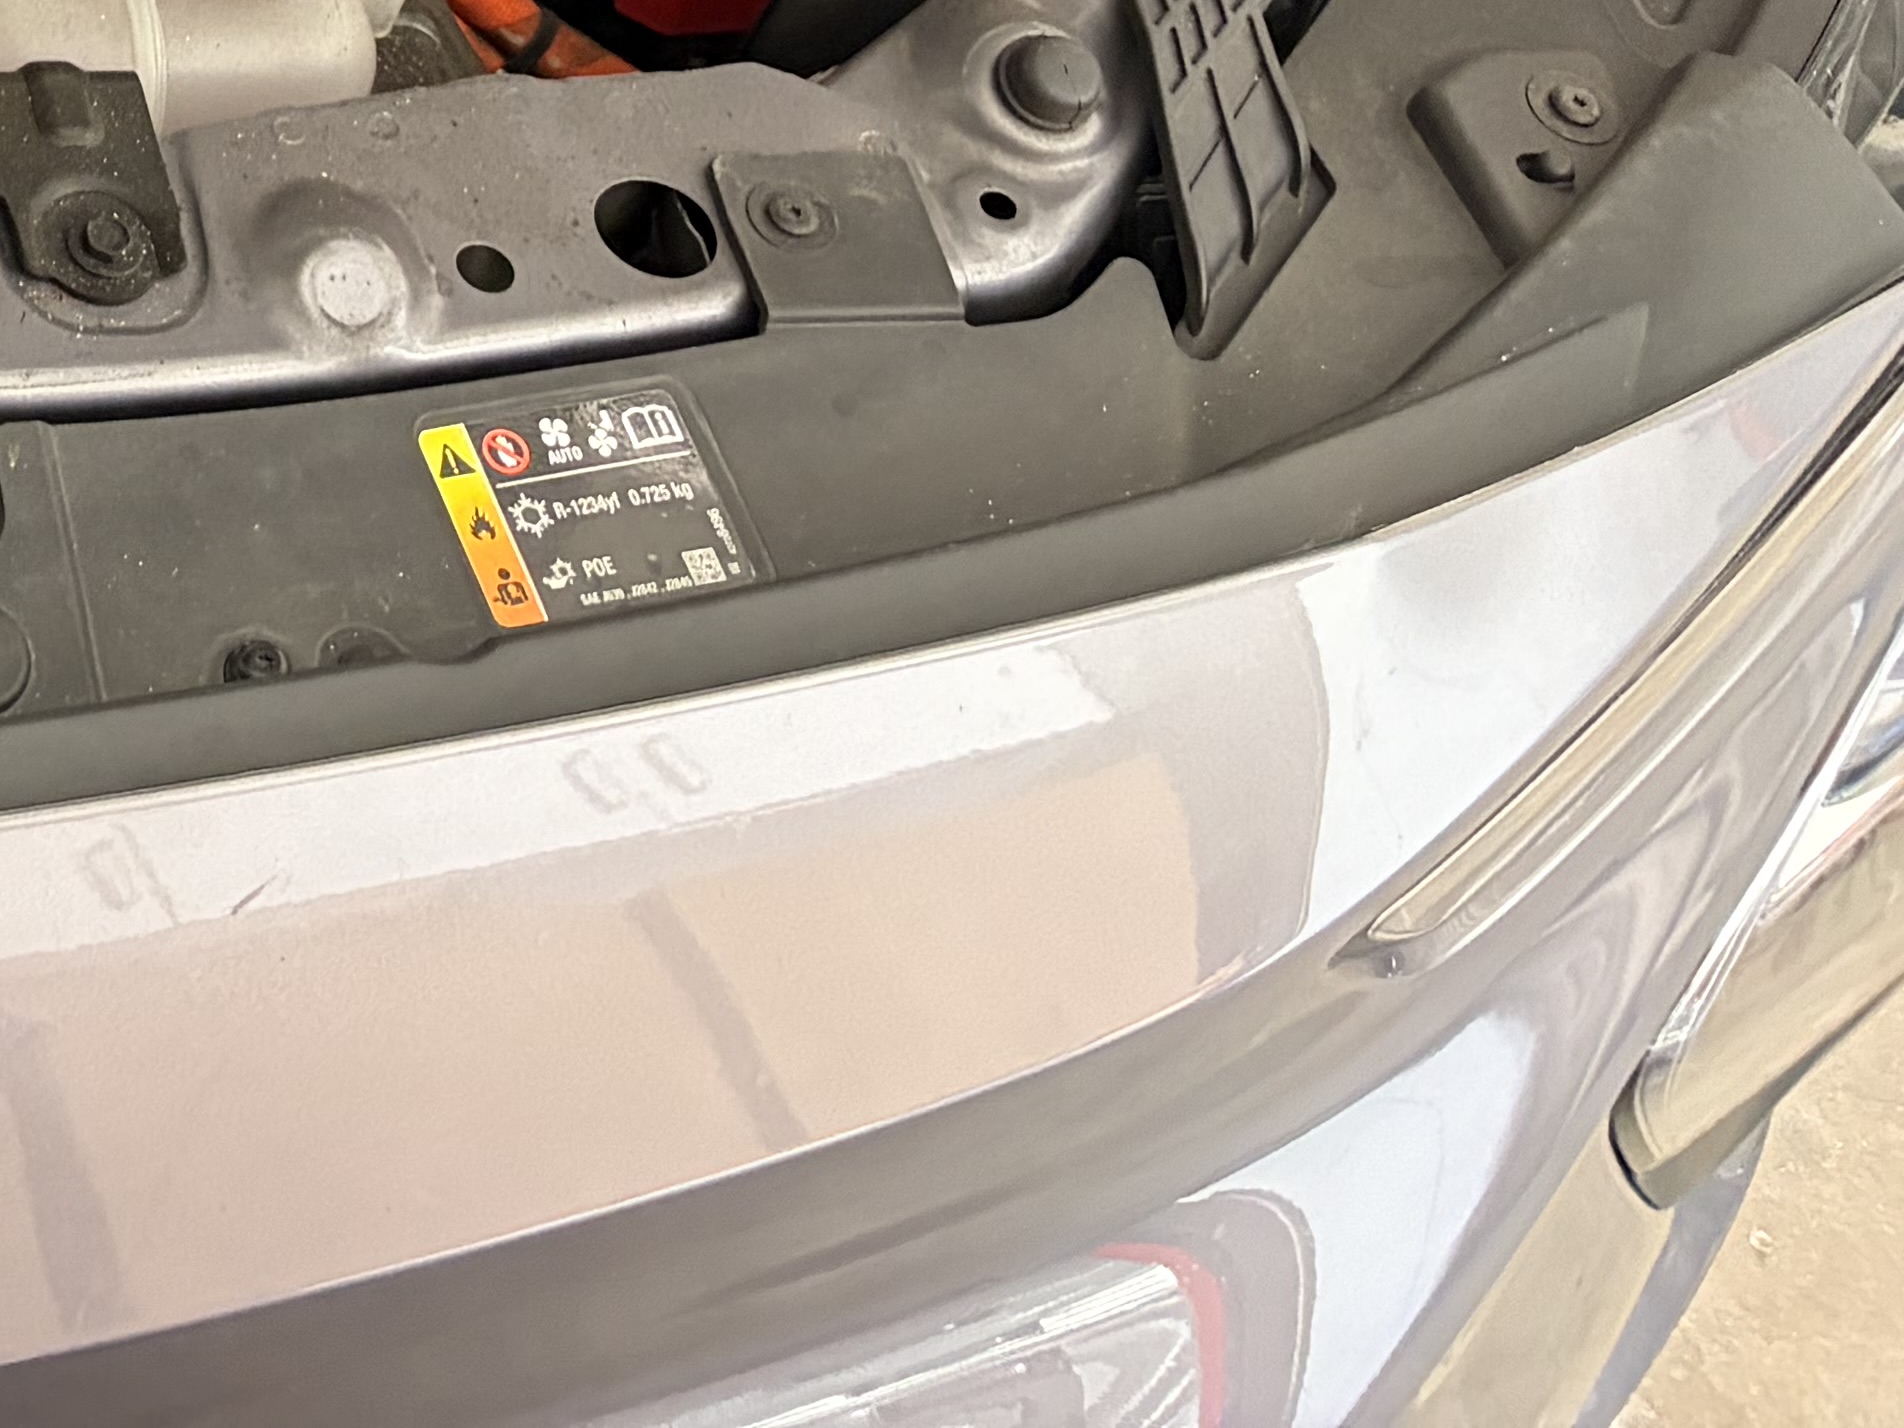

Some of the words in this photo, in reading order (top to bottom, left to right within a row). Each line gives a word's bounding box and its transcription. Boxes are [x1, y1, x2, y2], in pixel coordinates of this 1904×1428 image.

[547, 444, 583, 465] AUTO
[551, 491, 621, 520] R-1234yf
[628, 483, 671, 507] 0.725
[672, 480, 693, 501] kg
[581, 556, 617, 579] POE
